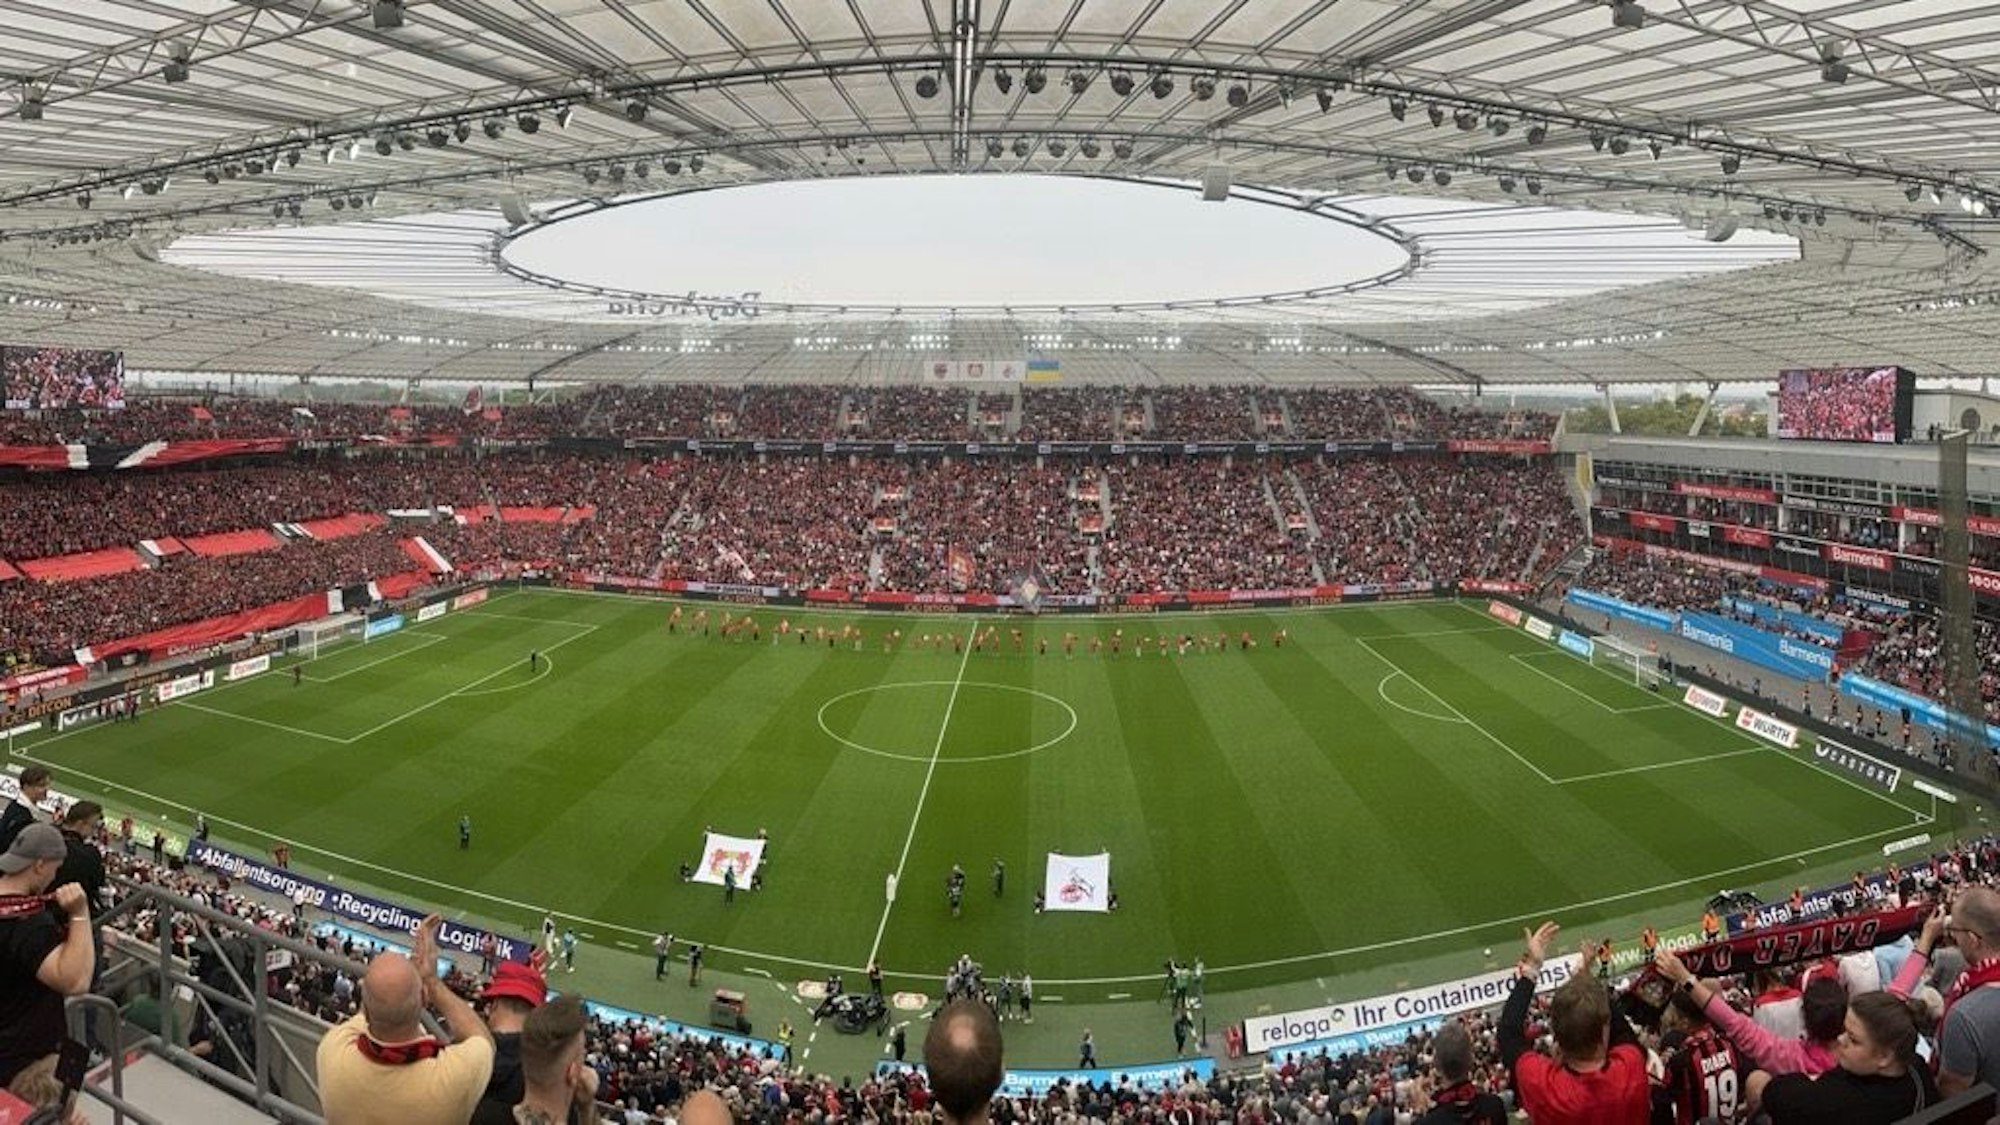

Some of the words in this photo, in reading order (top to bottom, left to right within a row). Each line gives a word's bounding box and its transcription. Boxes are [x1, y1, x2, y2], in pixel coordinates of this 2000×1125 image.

[1831, 547, 1885, 569] Barmenia
[1683, 620, 1733, 652] Barmenia
[1780, 639, 1832, 668] Barmenia
[1829, 750, 1894, 787] CASTORE
[439, 922, 513, 961] Logiik
[1262, 1016, 1331, 1042] reloga
[1354, 1005, 1387, 1028] Ihr
[1395, 960, 1573, 1018] Containerdnst
[1701, 1049, 1732, 1075] DIABY
[1704, 1068, 1738, 1119] 19
